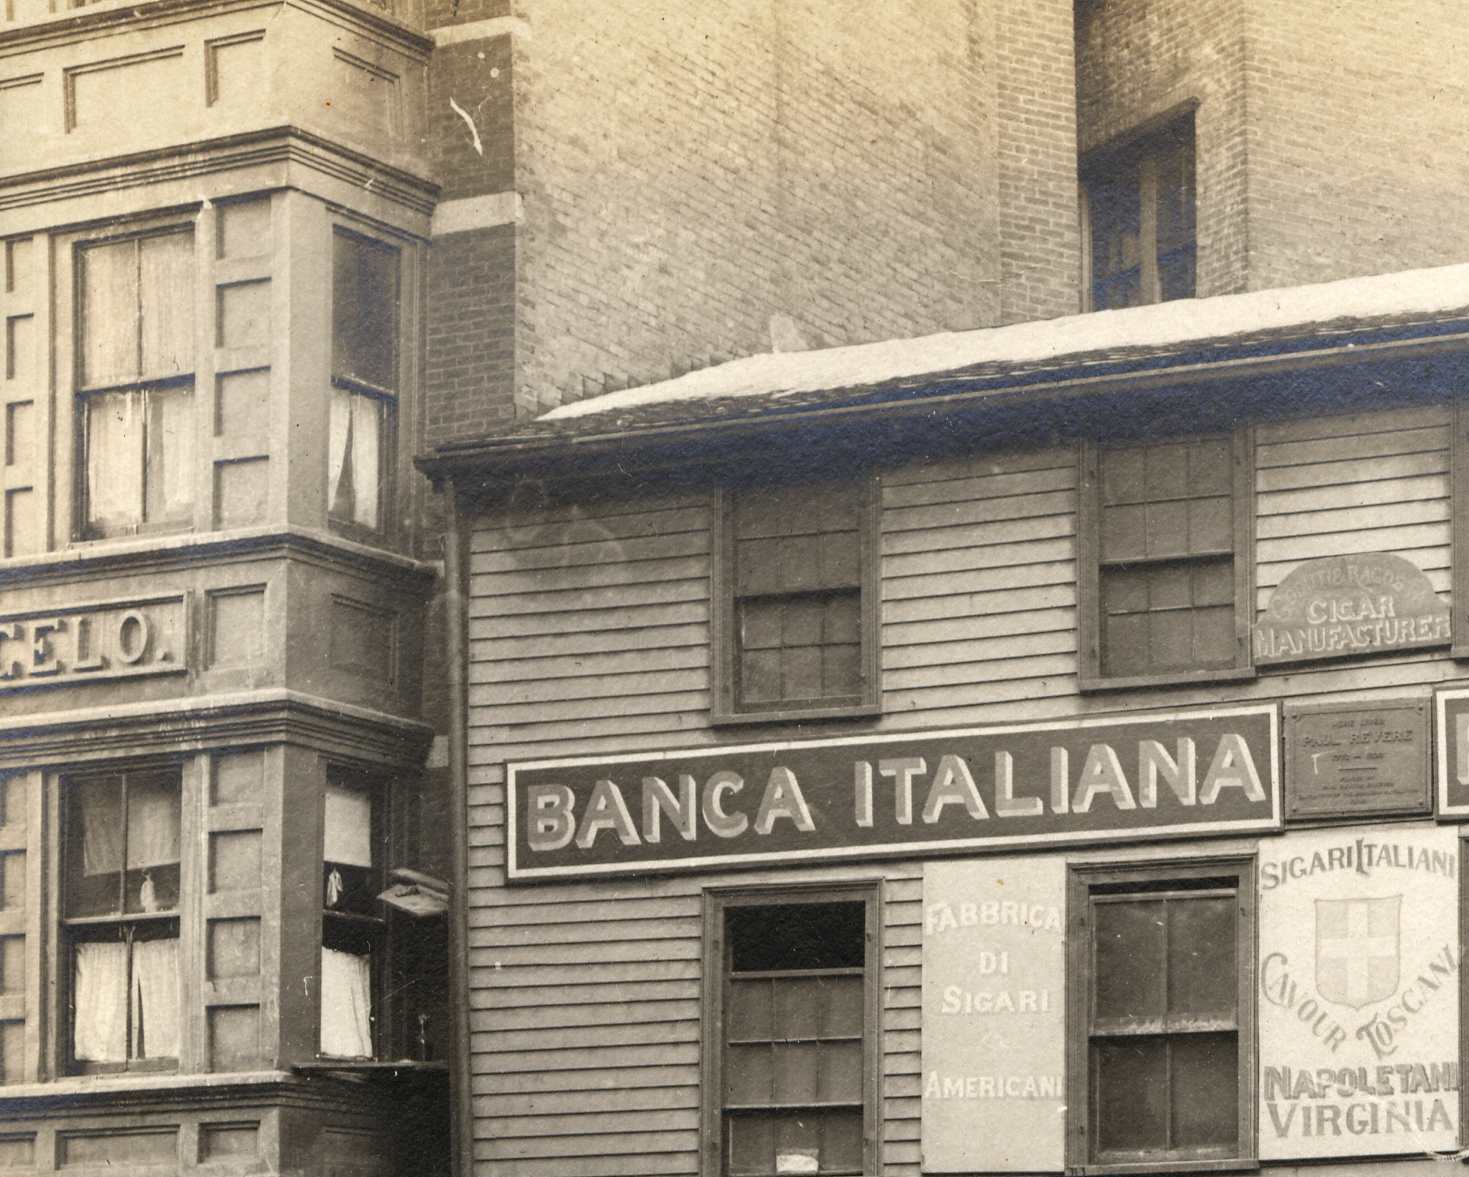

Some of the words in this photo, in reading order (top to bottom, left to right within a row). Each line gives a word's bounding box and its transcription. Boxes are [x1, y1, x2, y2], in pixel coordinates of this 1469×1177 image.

[1306, 594, 1396, 625] CIGAR
[1349, 729, 1414, 745] REVERE
[528, 765, 816, 852] BANCA
[853, 732, 1266, 828] ITALIANA
[1260, 847, 1355, 891] SIGARI
[1356, 839, 1456, 880] ITALIANI
[925, 900, 1062, 936] FABBRICA
[979, 951, 1009, 976] DI
[941, 985, 1050, 1016] SIGARI
[1260, 952, 1348, 1054] CAVOUR
[1356, 943, 1459, 1061] TOSCANI
[925, 1071, 1062, 1101] AMERICANI
[1264, 1061, 1459, 1101] NAPOLETANI
[1266, 1099, 1455, 1138] VIRGINIA
